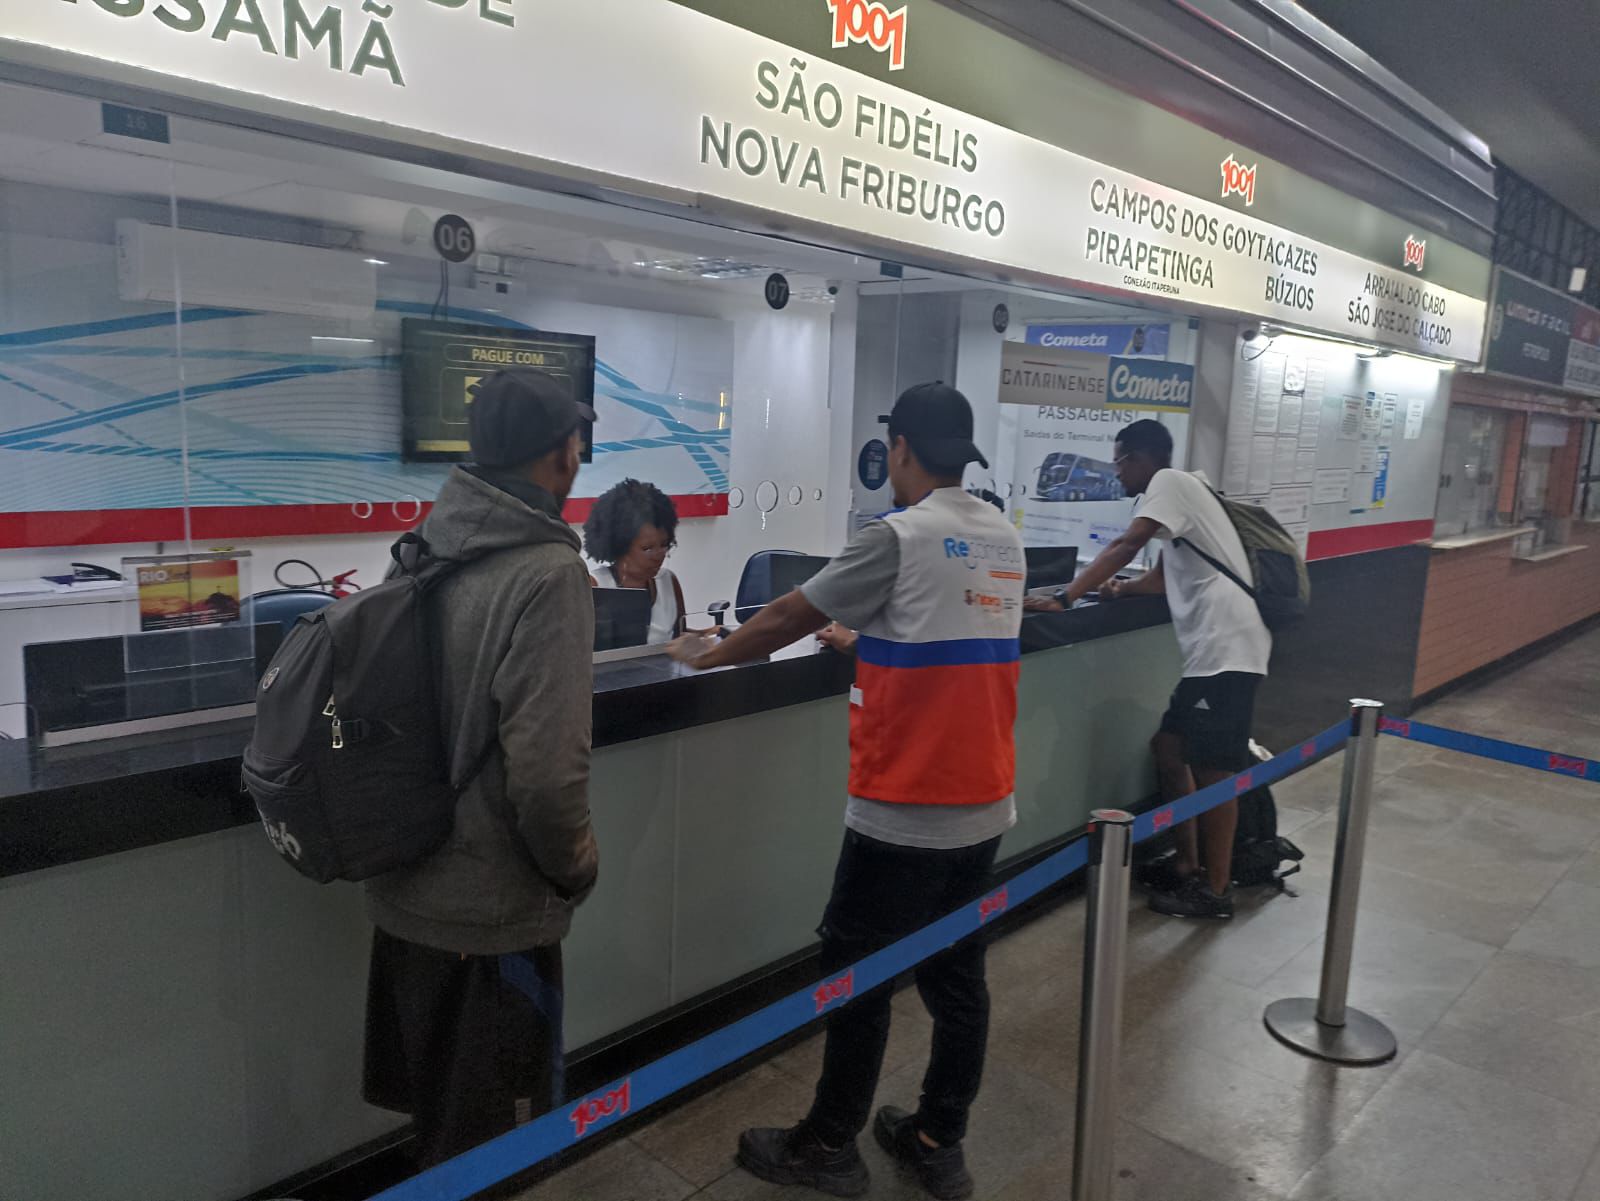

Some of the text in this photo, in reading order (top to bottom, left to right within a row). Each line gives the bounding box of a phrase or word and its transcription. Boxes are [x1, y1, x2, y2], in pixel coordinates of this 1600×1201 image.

[60, 0, 406, 88] SAMÃ
[828, 0, 907, 71] 1001
[755, 57, 978, 173] SÃO FIDÉLIS
[700, 115, 1005, 237] NOVA FRIBURGO
[1221, 153, 1257, 207] 1001
[439, 224, 473, 252] 06
[1090, 178, 1318, 276] CAMPOS DOS GOYTACAZES
[1085, 227, 1315, 311] PIRAPETINGA BÚZIOS
[1404, 234, 1426, 271] 1001
[1364, 272, 1446, 317] ARRAIAL DO CABO
[1040, 332, 1109, 348] Cometa
[1347, 296, 1370, 325] SÃO
[1397, 313, 1411, 335] DO
[1413, 318, 1452, 346] CALÇADO
[472, 348, 544, 365] PAGUE COM
[1001, 368, 1105, 395] CATARINENSE
[1111, 364, 1191, 404] Cometa
[812, 970, 855, 1014] 1001
[569, 1077, 633, 1138] 1001
